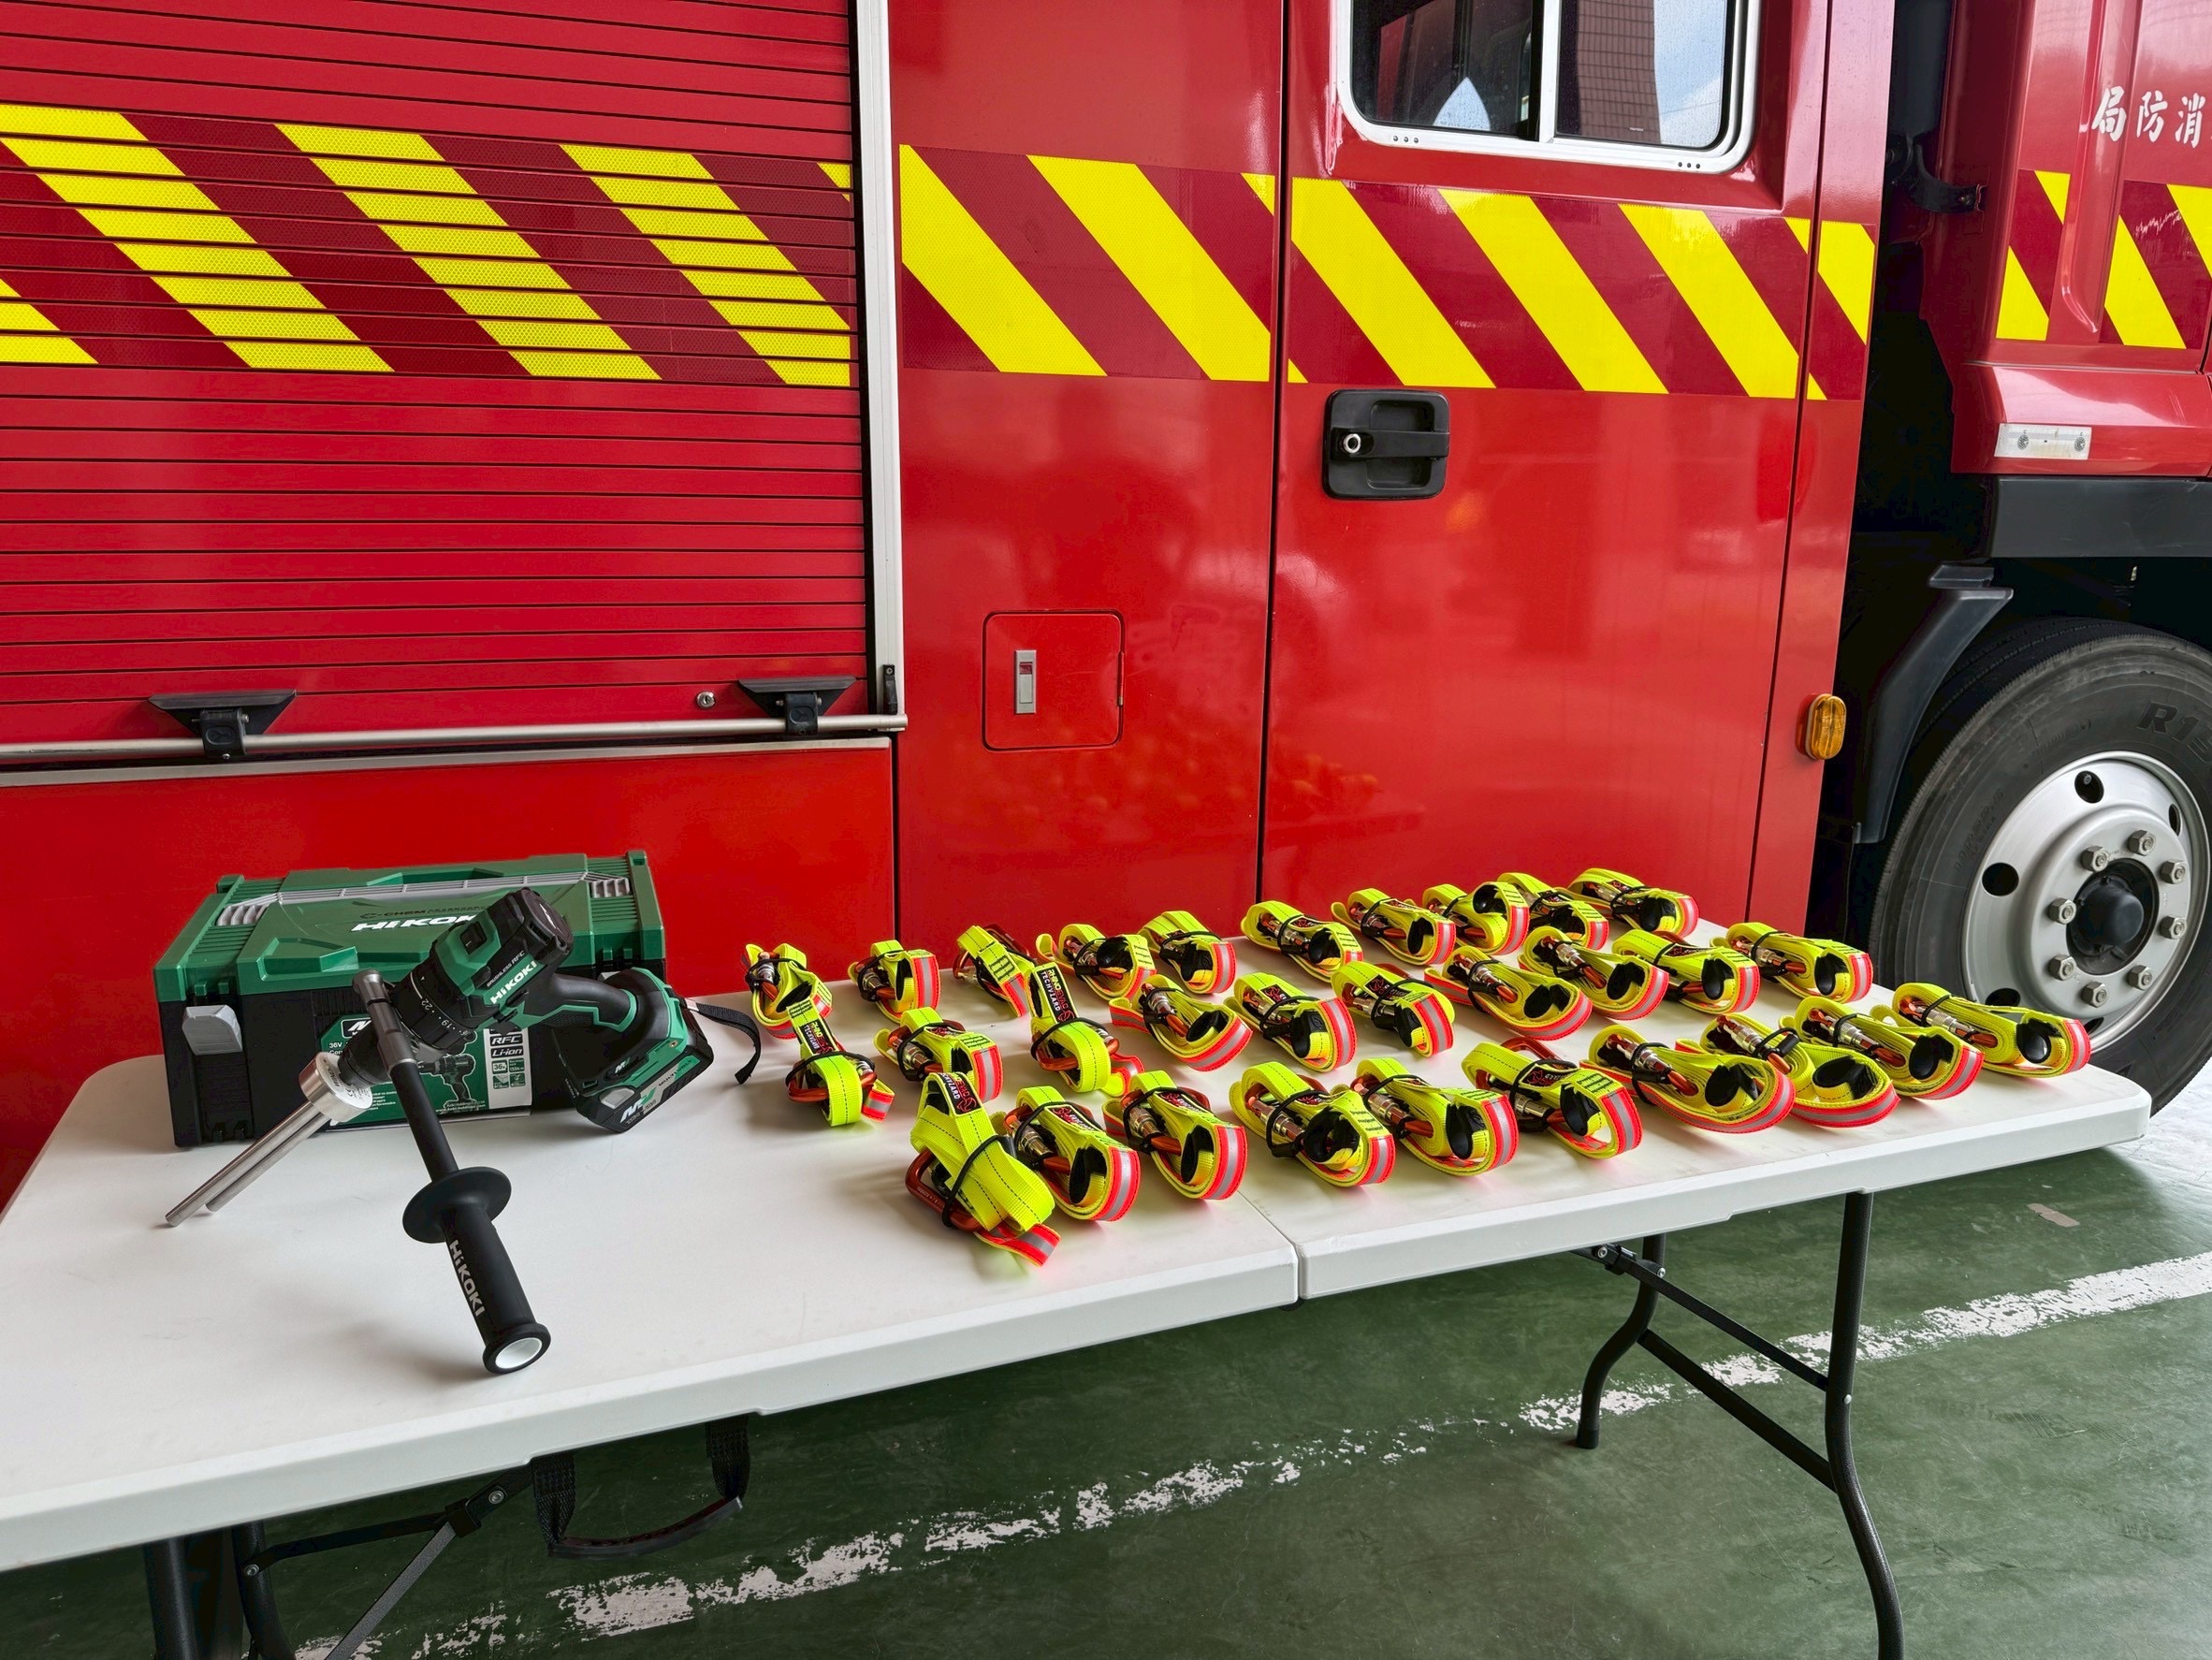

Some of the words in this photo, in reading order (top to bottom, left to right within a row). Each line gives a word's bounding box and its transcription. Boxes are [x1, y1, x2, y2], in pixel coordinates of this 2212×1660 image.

[351, 914, 476, 932] HiKOK
[492, 1035, 521, 1045] RFC
[492, 1048, 523, 1057] Li-ion
[449, 1239, 486, 1317] HiKOKI
